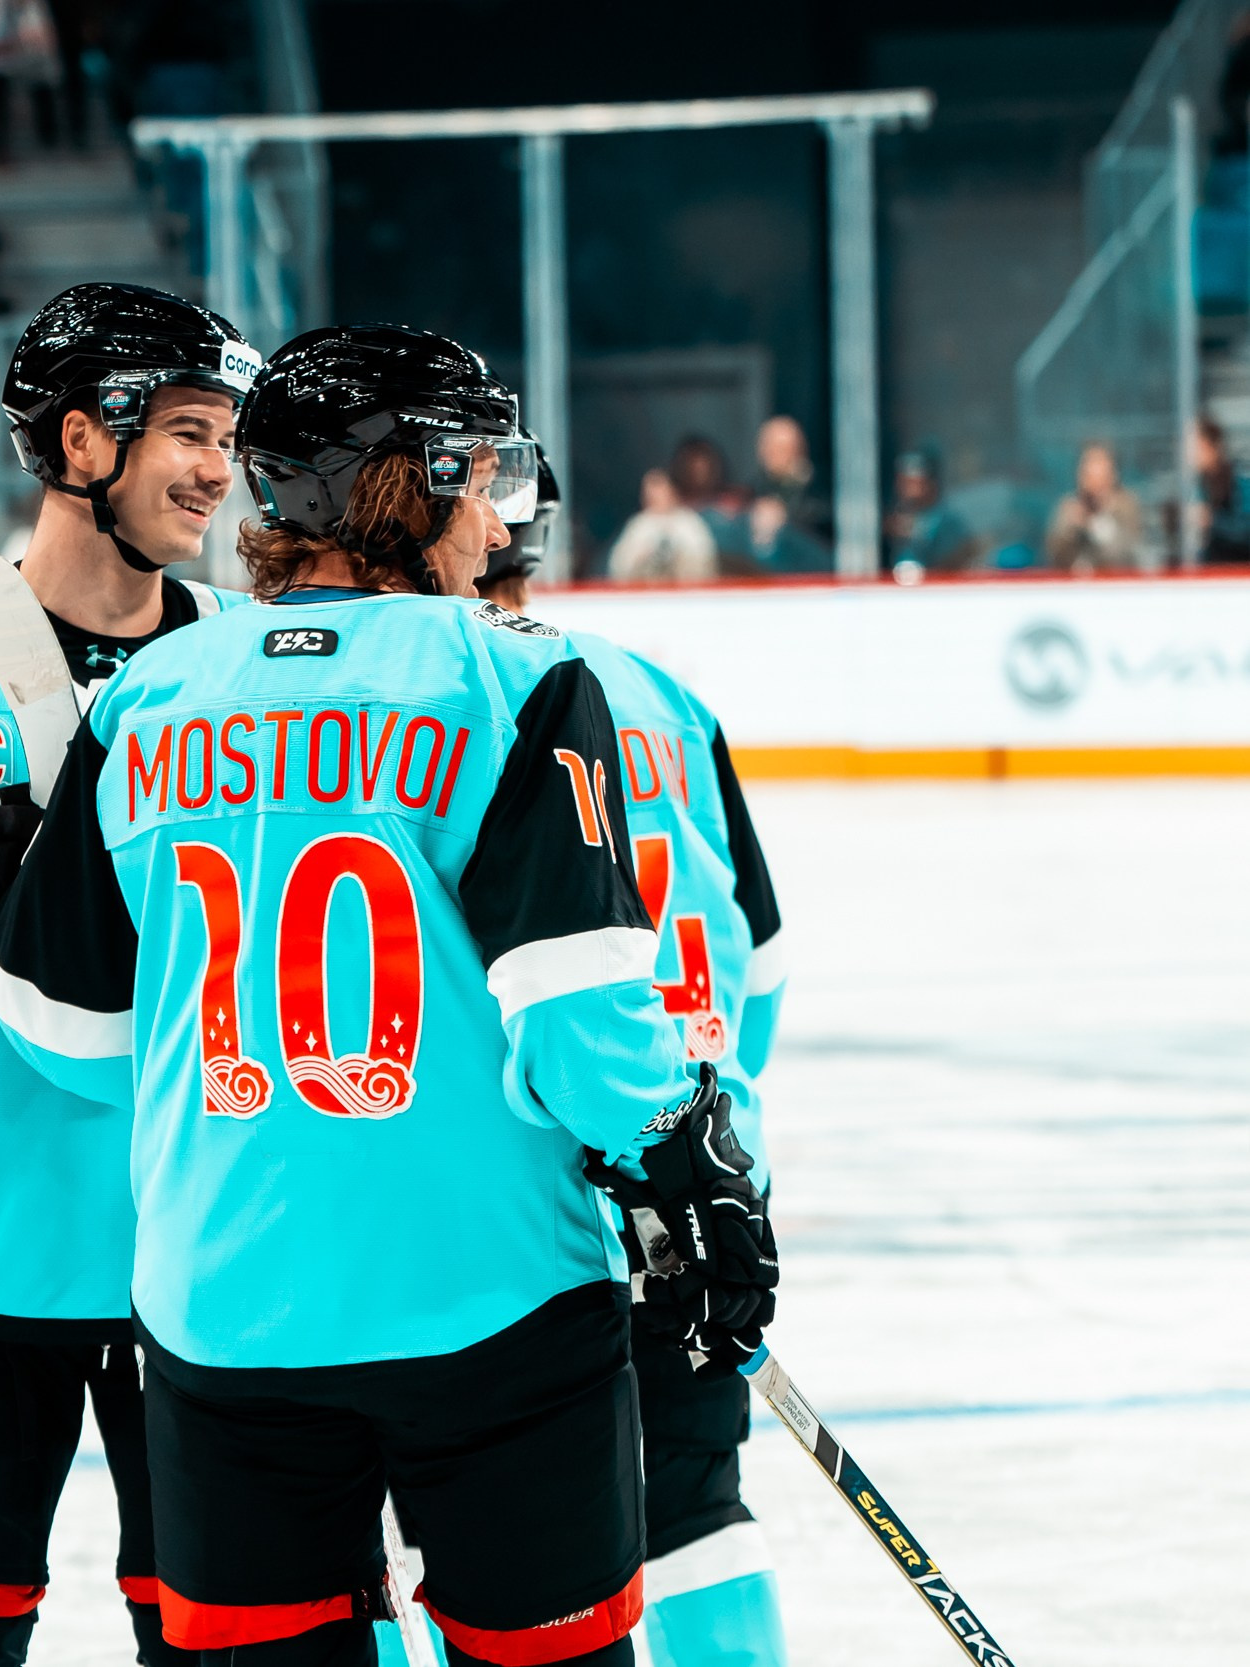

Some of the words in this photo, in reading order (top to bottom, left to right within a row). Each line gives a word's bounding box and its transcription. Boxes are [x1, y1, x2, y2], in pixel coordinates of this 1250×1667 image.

[399, 414, 463, 429] TRUE
[127, 709, 471, 823] MOSTOVOI
[618, 728, 689, 808] DIN
[171, 832, 425, 1120] 10
[686, 1203, 706, 1260] TRUE
[783, 1401, 808, 1430] CHNOLOGY
[857, 1491, 921, 1567] SUPER
